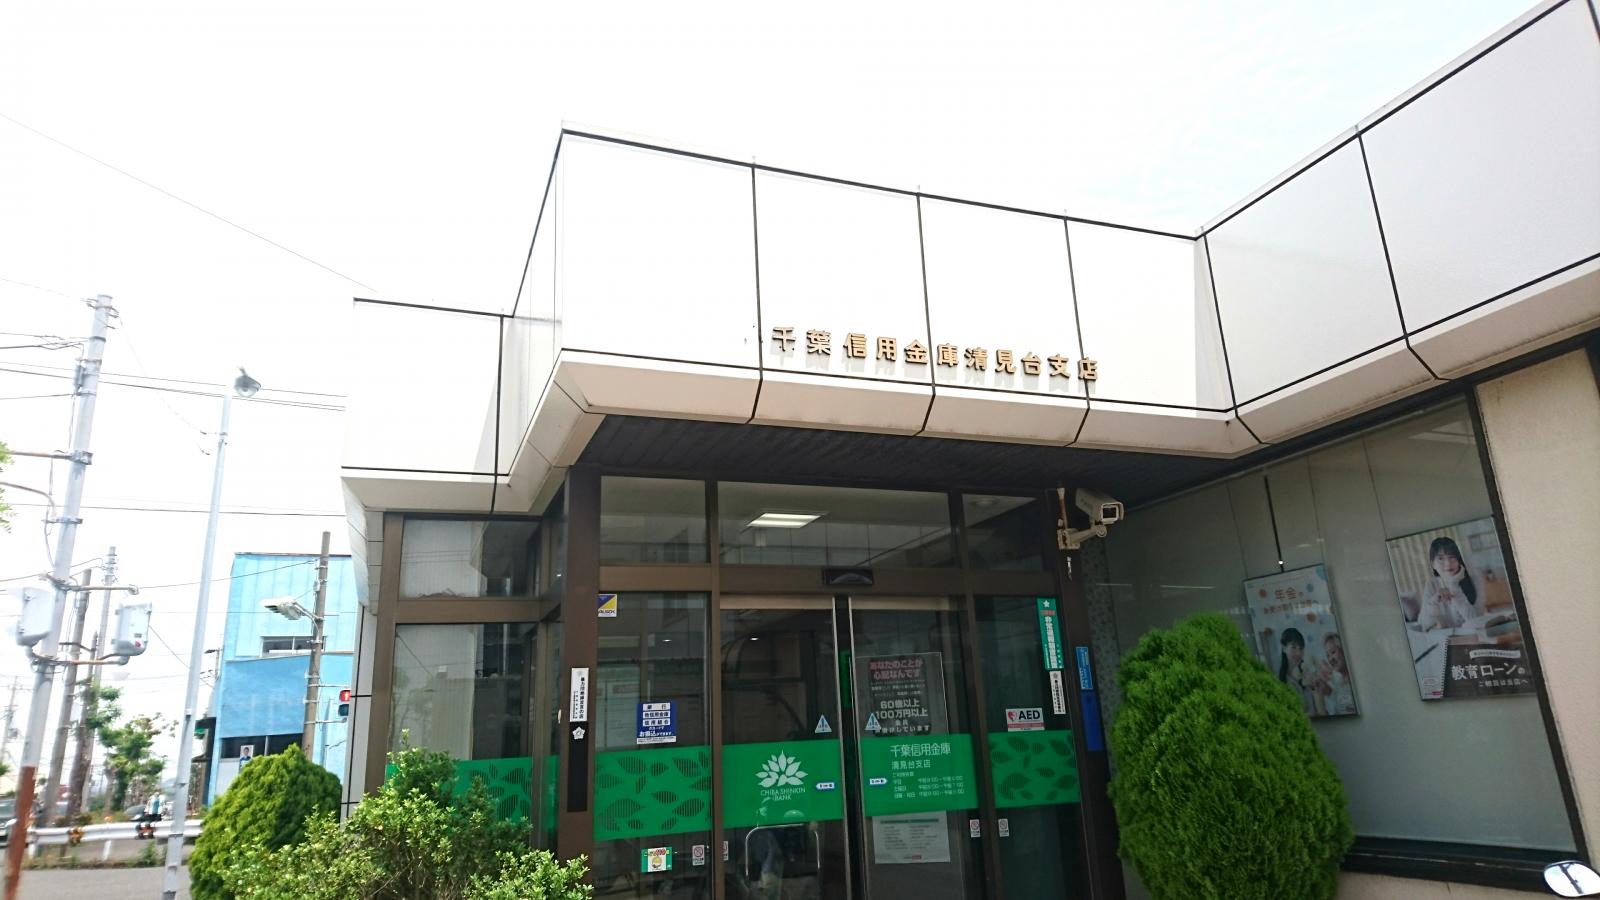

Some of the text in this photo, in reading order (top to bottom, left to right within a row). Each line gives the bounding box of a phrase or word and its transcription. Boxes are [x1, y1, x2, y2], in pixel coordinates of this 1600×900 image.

[1451, 663, 1526, 681] 教育ローンの
[1018, 710, 1041, 721] AED
[890, 742, 951, 758] 千葉信用金庫
[891, 759, 931, 771] 清見台支店
[760, 789, 779, 797] CHIBA
